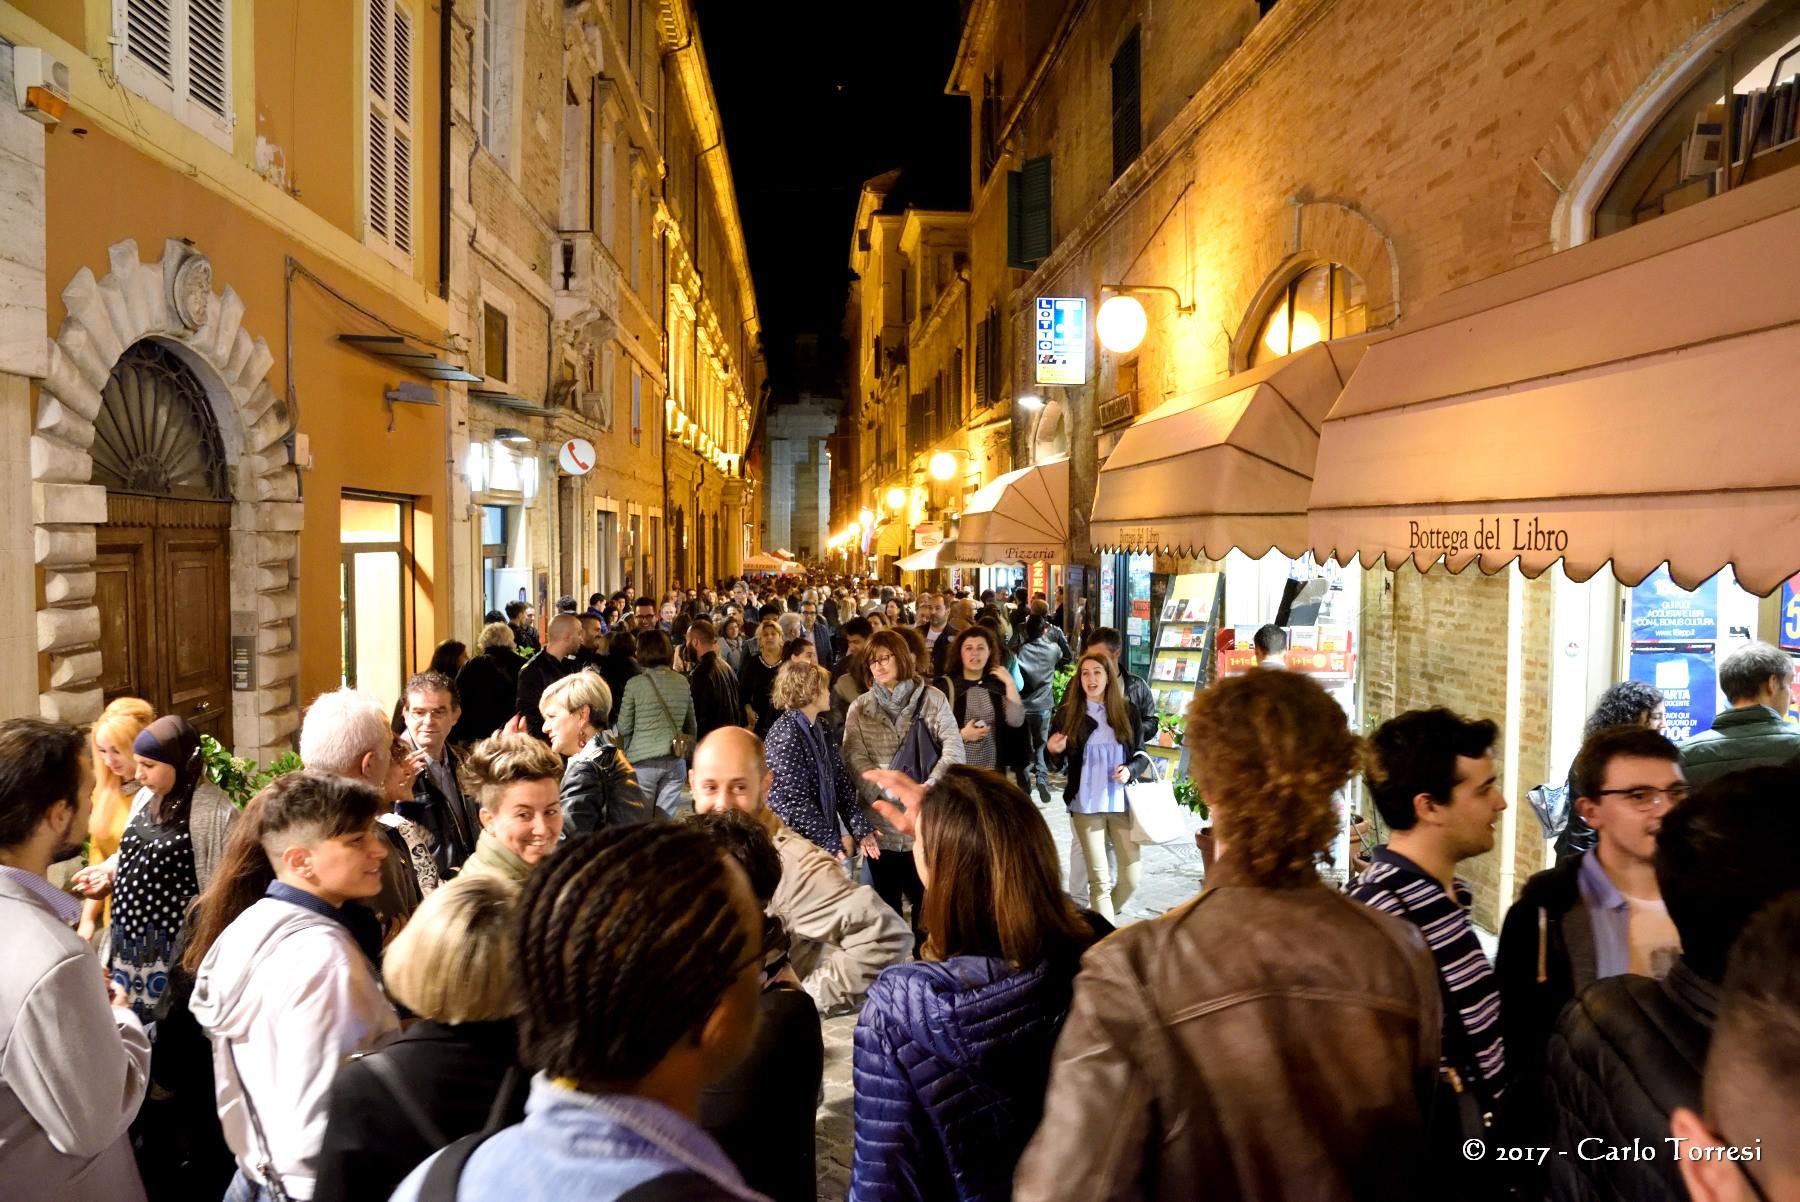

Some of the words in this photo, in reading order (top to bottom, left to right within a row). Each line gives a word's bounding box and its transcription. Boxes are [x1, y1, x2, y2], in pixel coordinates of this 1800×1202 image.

[1039, 299, 1053, 350] LOTTO
[1409, 520, 1469, 556] Bottega
[1474, 518, 1500, 550] del
[1513, 516, 1569, 551] Libro
[1005, 547, 1055, 559] Pizzeria
[1660, 618, 1683, 626] BONUS
[1685, 618, 1714, 626] CULTURA
[1663, 690, 1690, 699] ARTA
[1660, 727, 1691, 740] 00€
